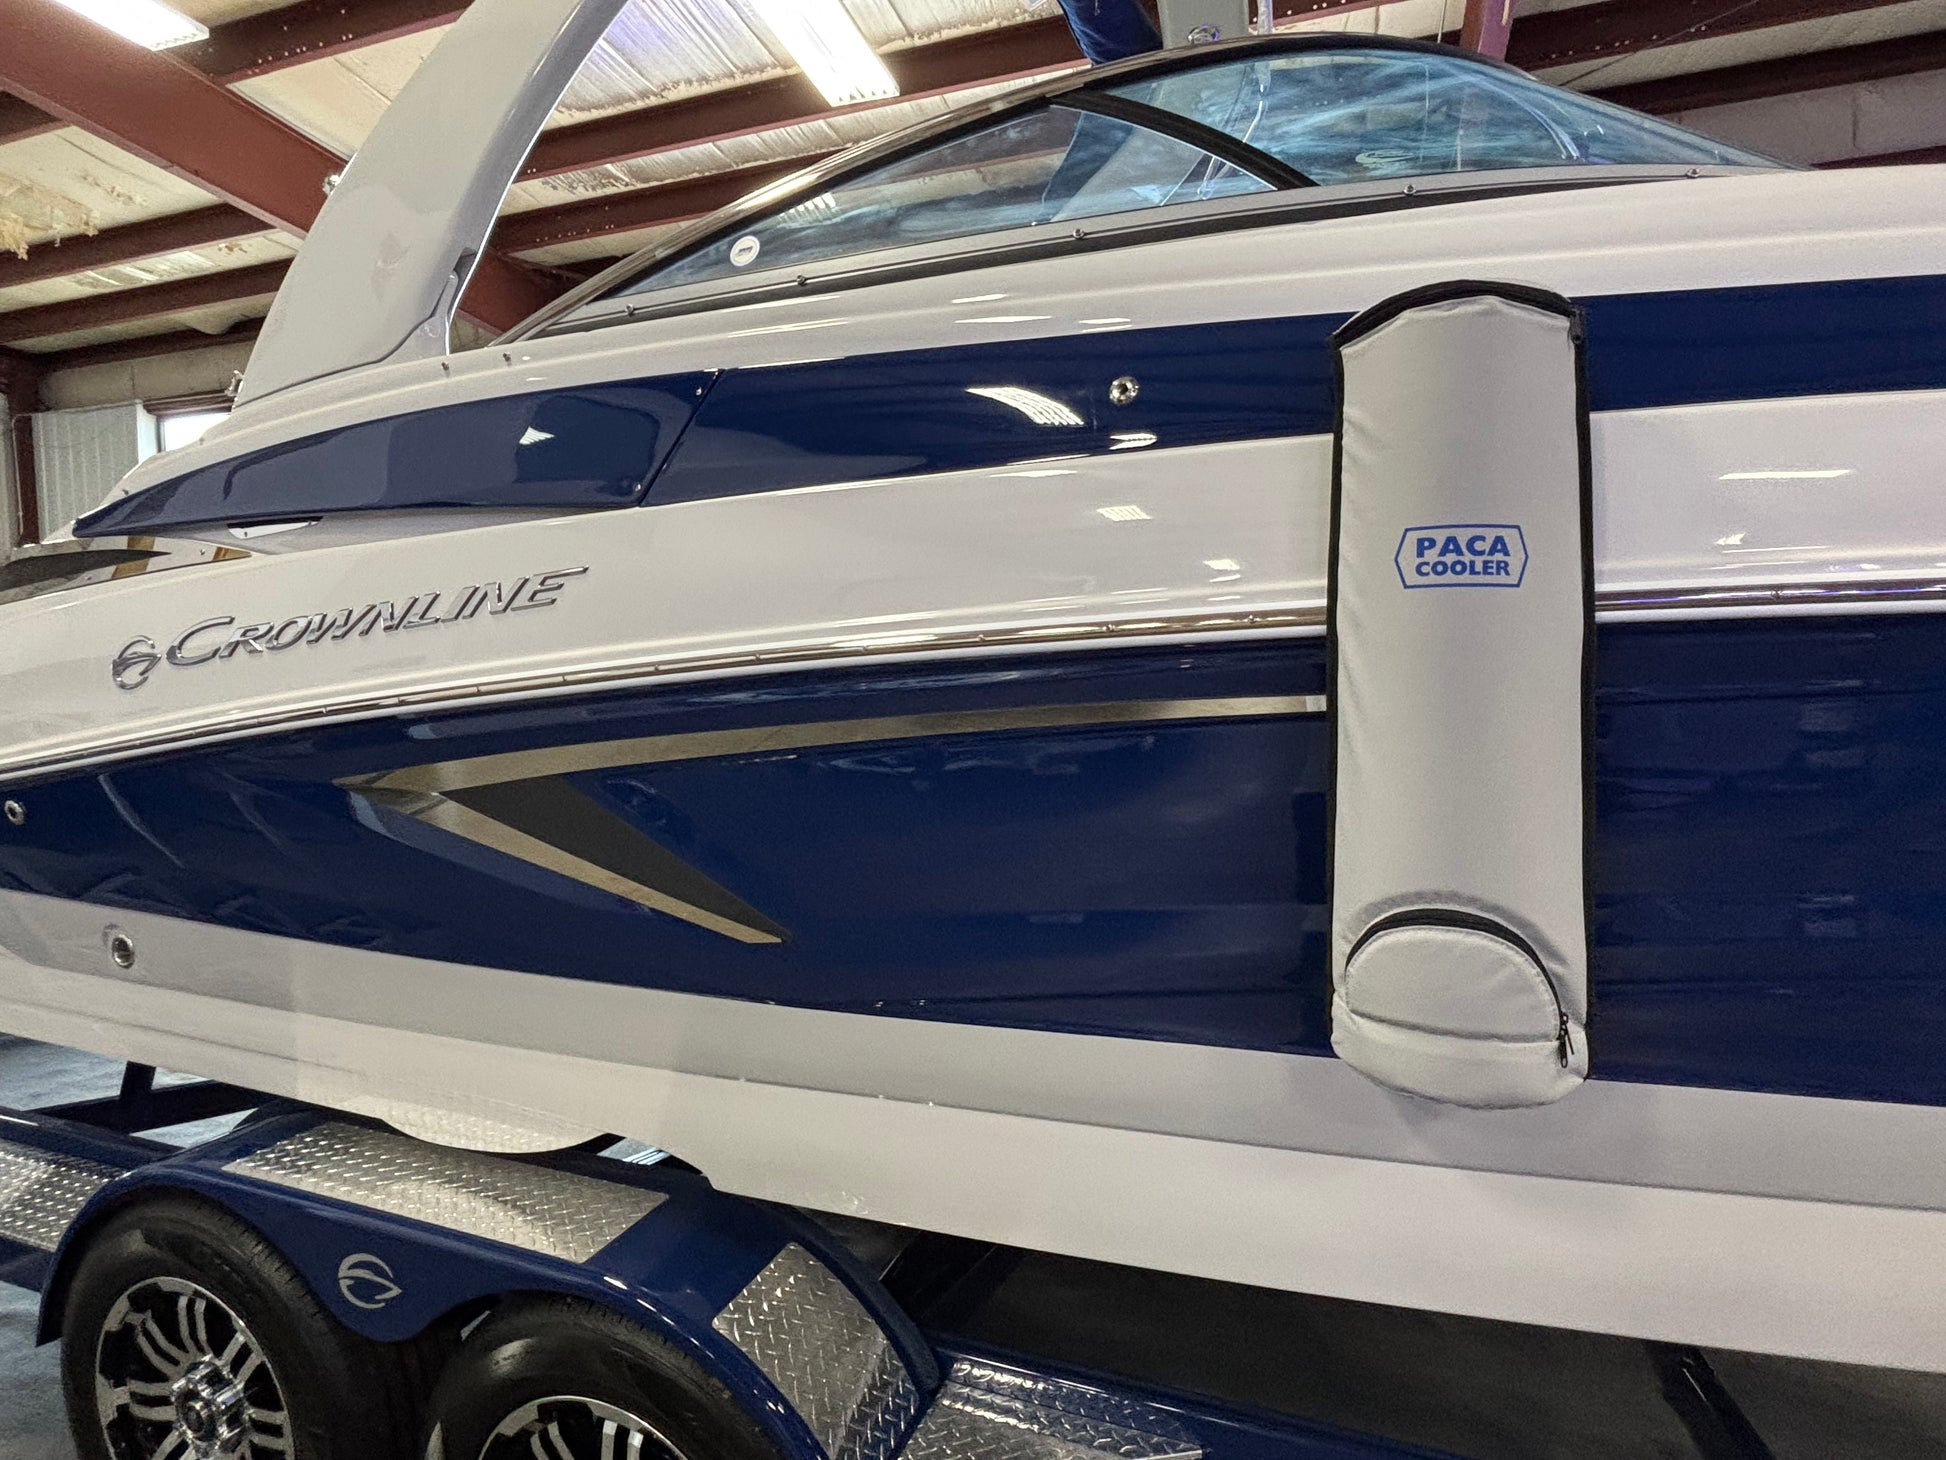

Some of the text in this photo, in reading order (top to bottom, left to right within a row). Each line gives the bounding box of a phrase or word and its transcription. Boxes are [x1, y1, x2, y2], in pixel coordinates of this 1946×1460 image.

[1416, 535, 1511, 558] PACA
[1415, 560, 1511, 576] COOLER
[166, 564, 590, 667] CROWNLINE
